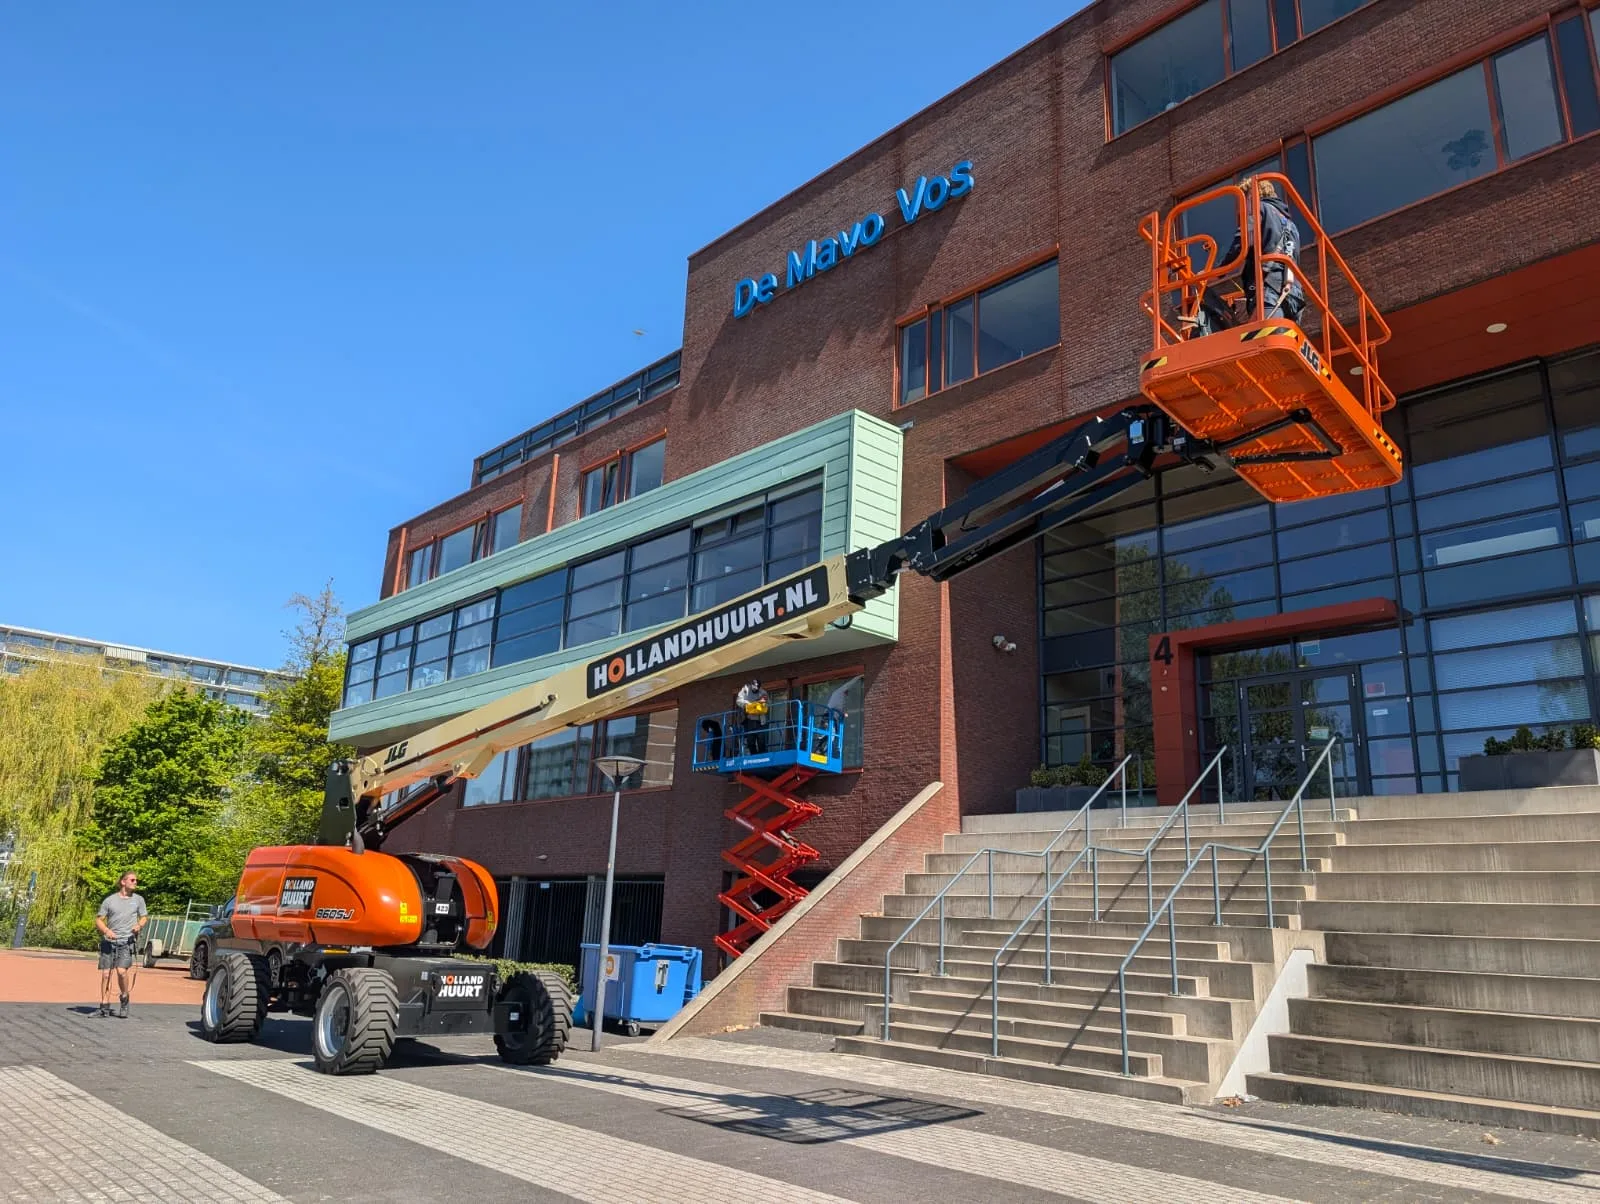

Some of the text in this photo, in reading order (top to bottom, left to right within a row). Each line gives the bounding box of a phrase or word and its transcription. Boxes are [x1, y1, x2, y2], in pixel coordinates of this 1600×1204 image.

[734, 160, 975, 319] De Mavo Vos
[1300, 341, 1319, 372] JLG
[594, 578, 818, 690] HOLLANDHUURT.NL
[1153, 636, 1174, 665] 4
[384, 741, 409, 766] JLG
[284, 879, 315, 890] HOLLAND
[281, 891, 312, 905] HUURT
[315, 908, 355, 920] 860SJ
[440, 974, 484, 985] HOLLAND
[438, 985, 483, 997] HUURT
